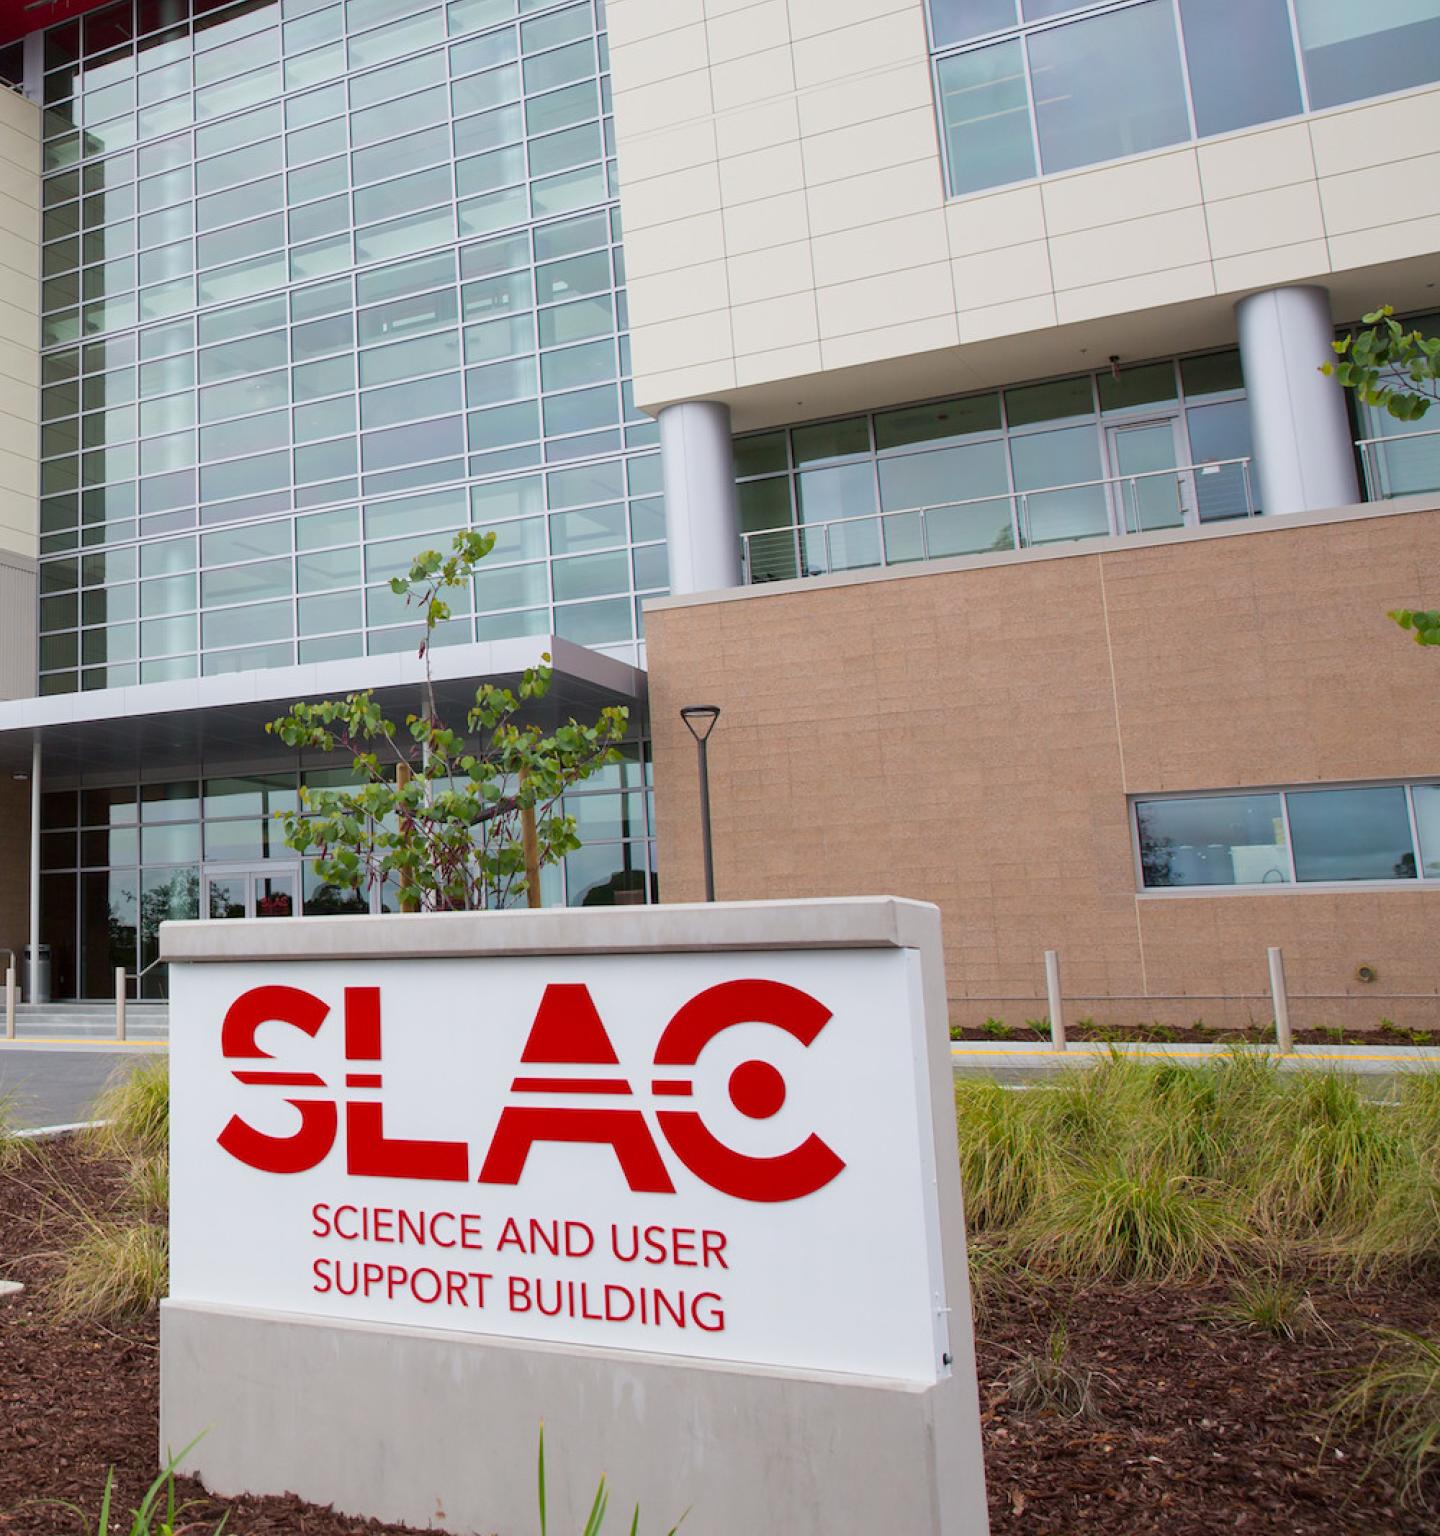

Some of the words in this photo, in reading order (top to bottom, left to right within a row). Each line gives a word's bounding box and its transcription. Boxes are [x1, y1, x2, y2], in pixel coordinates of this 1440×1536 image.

[216, 977, 847, 1204] SLAC
[311, 1202, 483, 1251] SCIENCE
[495, 1216, 596, 1259] AND
[610, 1223, 729, 1270] USER
[312, 1257, 494, 1310] SUPPORT
[507, 1275, 727, 1334] BUILDING
